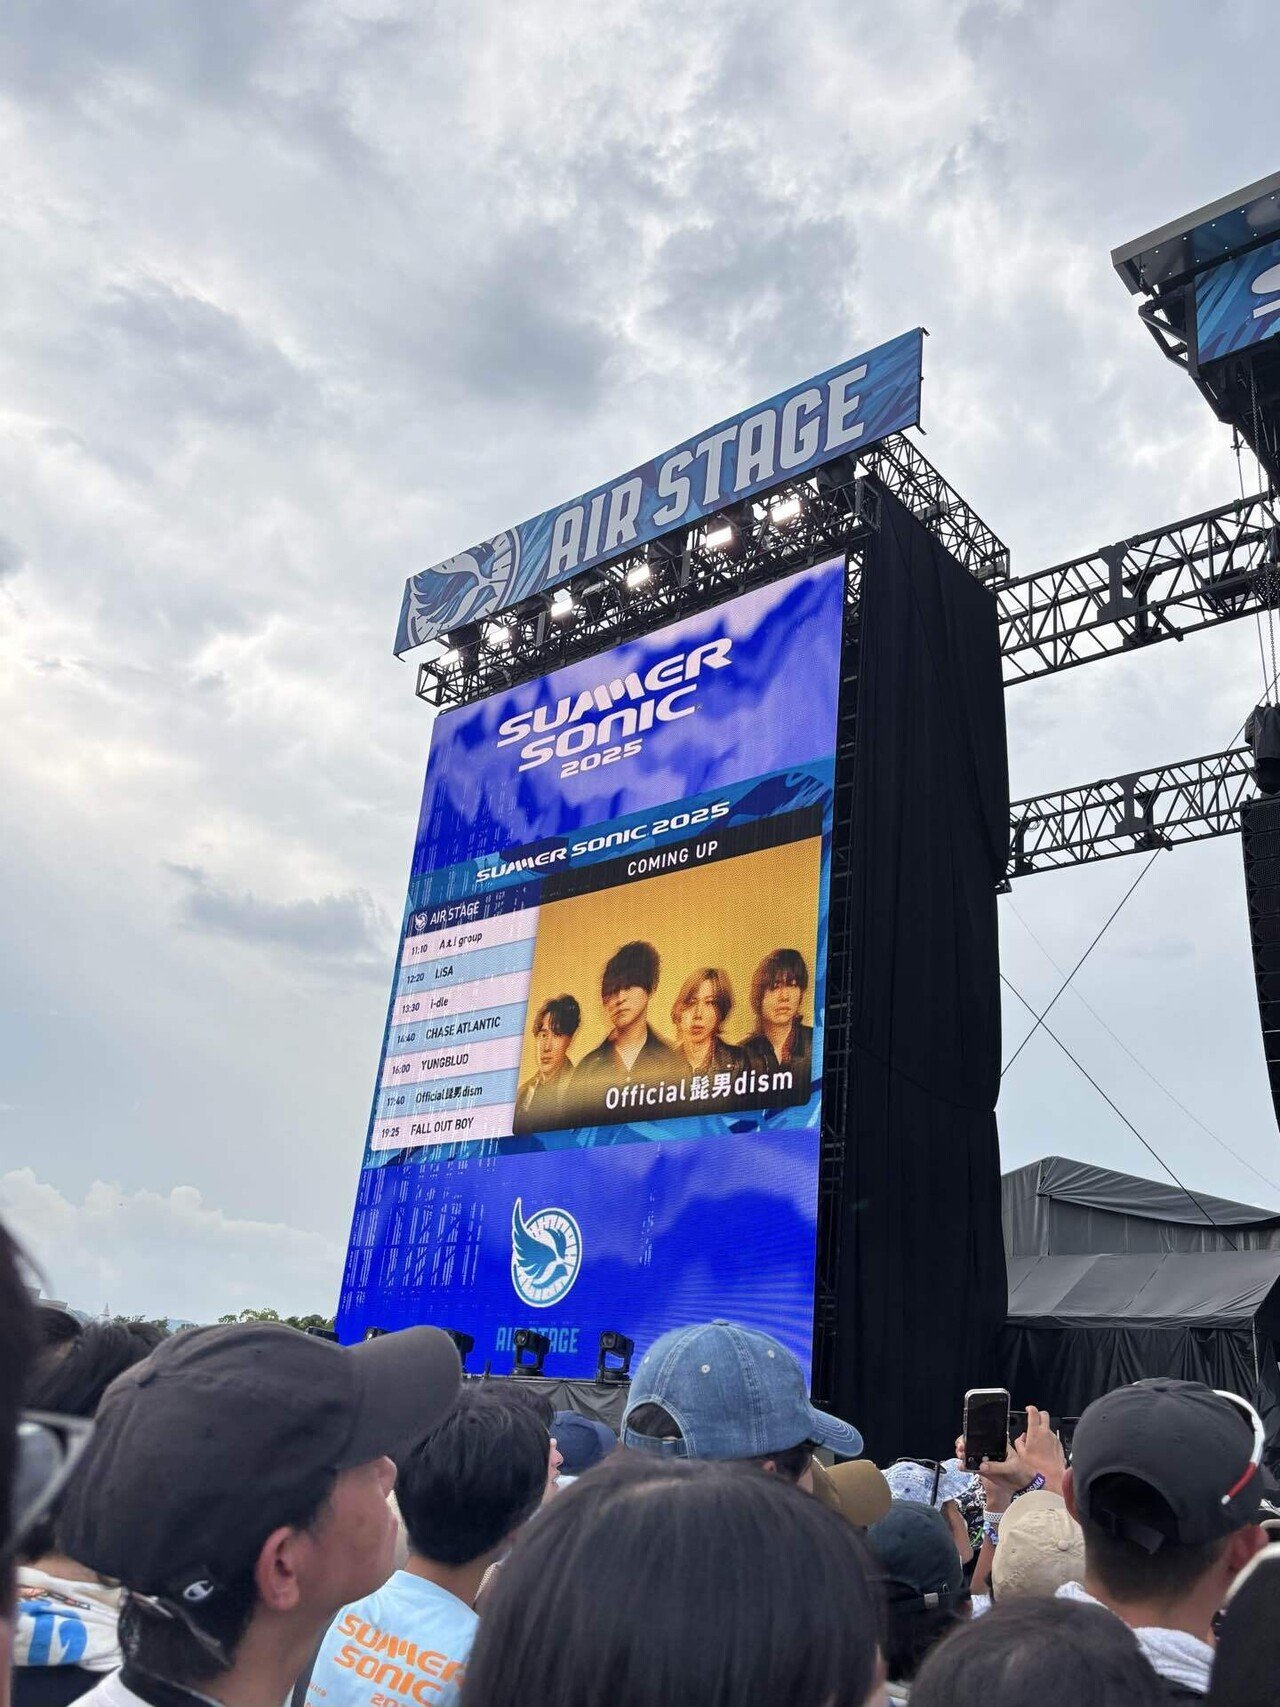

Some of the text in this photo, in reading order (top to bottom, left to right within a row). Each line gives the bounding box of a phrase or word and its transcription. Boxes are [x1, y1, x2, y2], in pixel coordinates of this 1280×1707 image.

[546, 363, 867, 581] AIR STAGE
[497, 638, 732, 747] SUMMER
[519, 684, 697, 772] SONIC
[560, 738, 643, 779] 2025
[476, 801, 730, 883] SUMMER SONIC 2025
[627, 840, 719, 876] COMING UP
[429, 901, 480, 926] AIR STAGE
[411, 943, 428, 956] 11:10
[458, 932, 483, 947] group
[407, 973, 425, 984] 12:20
[435, 965, 454, 979] LiSA
[430, 997, 448, 1010] i-dle
[426, 1016, 501, 1040] CHASE ATLANTIC
[392, 1064, 411, 1075] 16:00
[421, 1053, 469, 1071] YUNGBLUD
[605, 1070, 794, 1110] Official髭男dism
[411, 1117, 474, 1136] FALL OUT BOY
